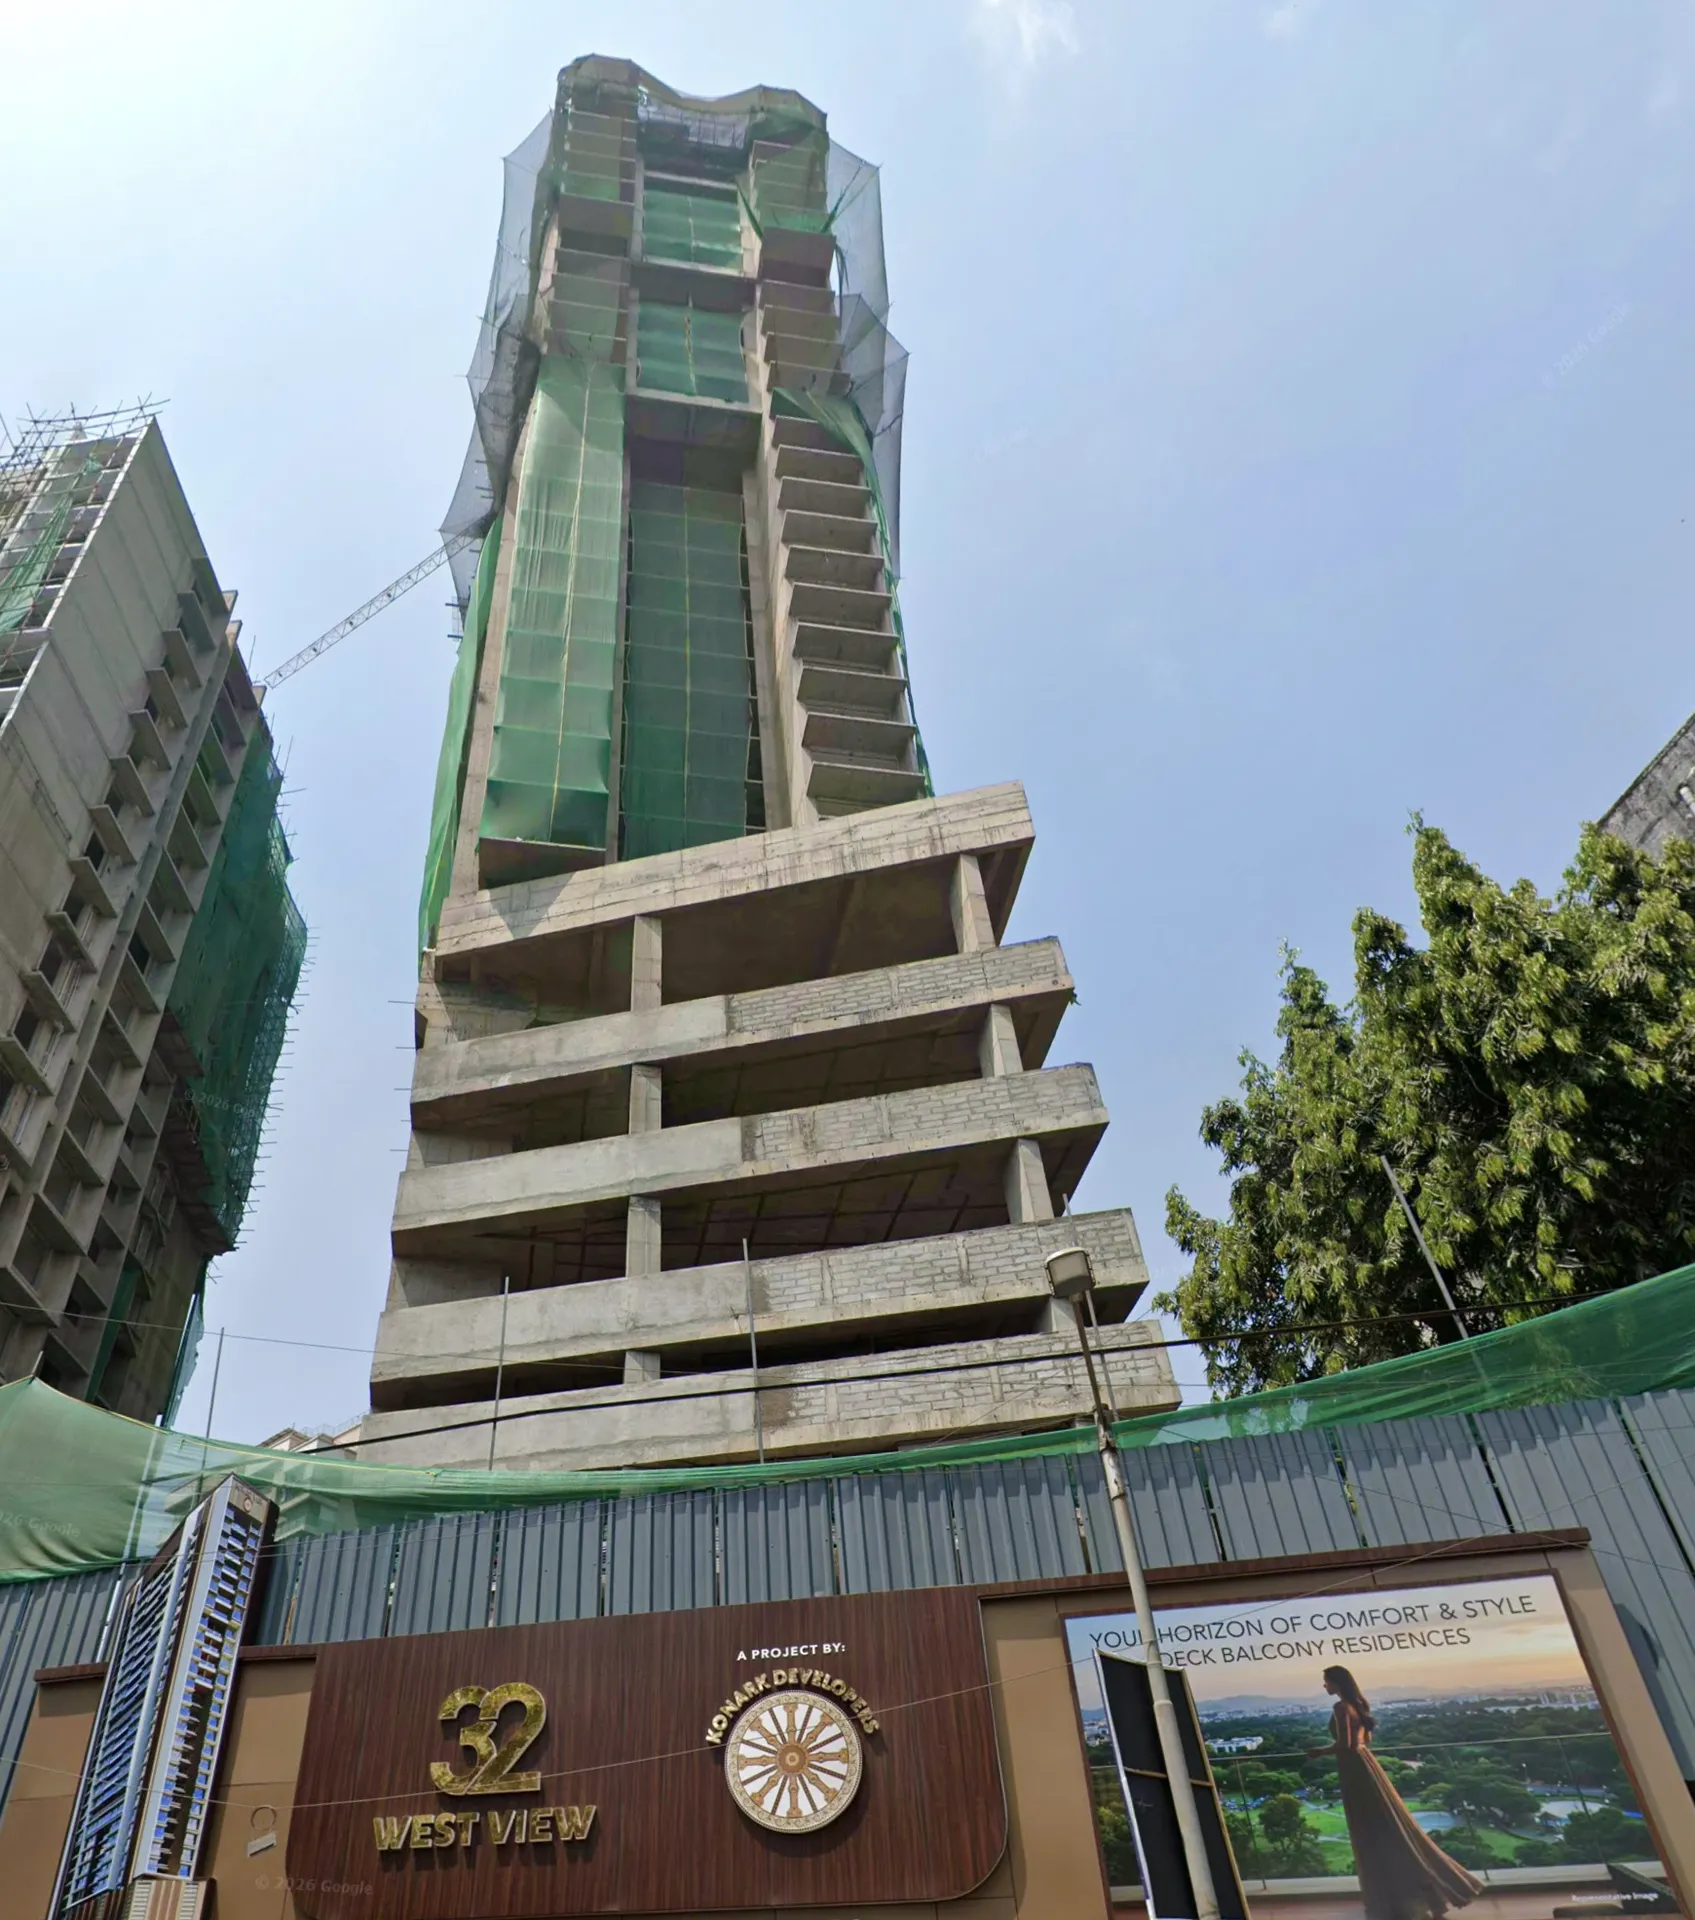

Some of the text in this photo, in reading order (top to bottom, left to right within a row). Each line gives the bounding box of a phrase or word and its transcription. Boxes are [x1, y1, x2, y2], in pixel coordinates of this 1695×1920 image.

[1089, 1595, 1537, 1649] YOU HORIZON OF COMFORT & STYLE
[1160, 1627, 1471, 1667] DECK BALCONY RESIDENCES
[736, 1642, 846, 1661] A PROJECT BY:
[705, 1667, 880, 1744] KONARK DEVELOPERS
[429, 1682, 547, 1796] 32
[372, 1804, 597, 1850] WEST VIEW
